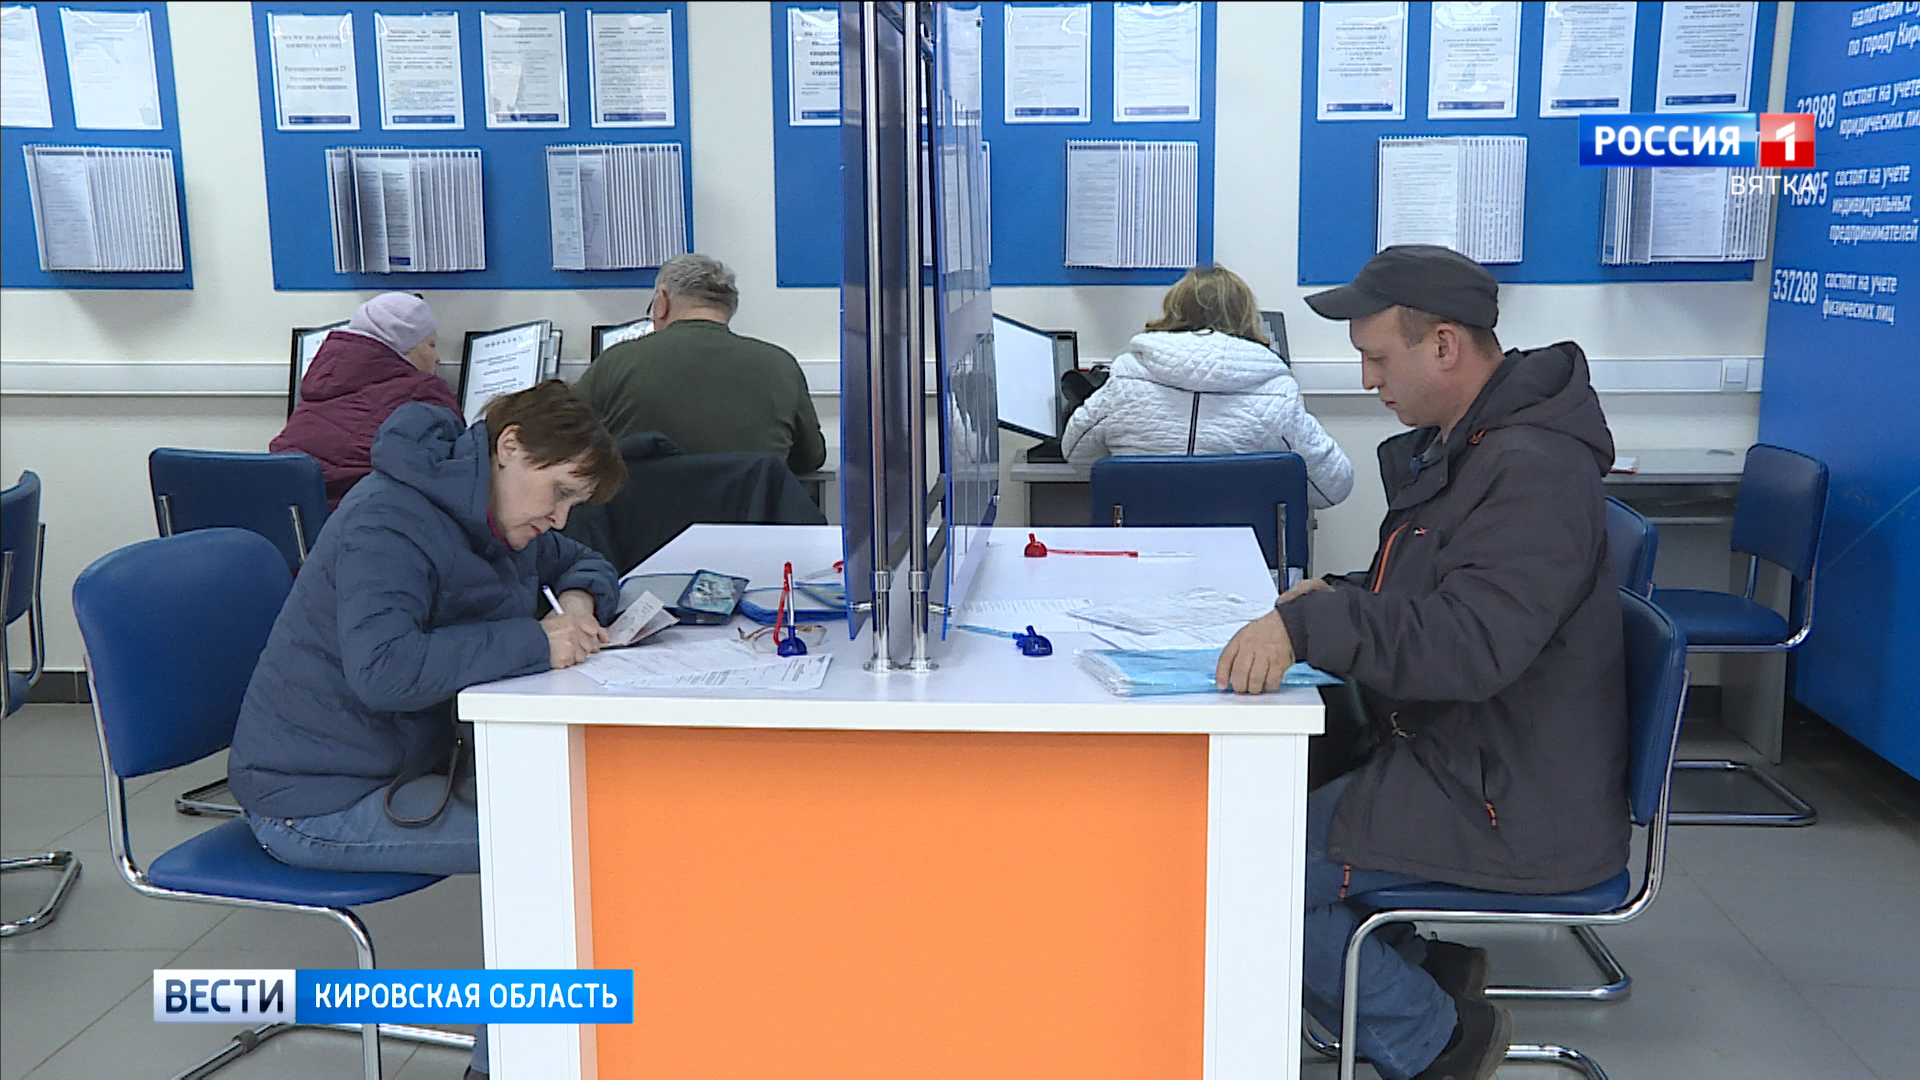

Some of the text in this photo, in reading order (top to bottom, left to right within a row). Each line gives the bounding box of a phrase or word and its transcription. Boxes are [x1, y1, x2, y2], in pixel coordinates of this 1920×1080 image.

[1848, 39, 1860, 56] по
[1860, 30, 1897, 58] городу
[1842, 86, 1878, 107] состоят
[1878, 84, 1892, 102] на
[1839, 109, 1920, 139] юридических ли
[1835, 169, 1868, 186] состоят
[1868, 168, 1881, 184] на
[1881, 165, 1910, 190] учете
[1832, 195, 1912, 218] индивидуальных
[1829, 218, 1919, 246] предпринимателей
[1773, 269, 1897, 304] 537288 состоят на учете
[1822, 294, 1895, 325] физических лиц
